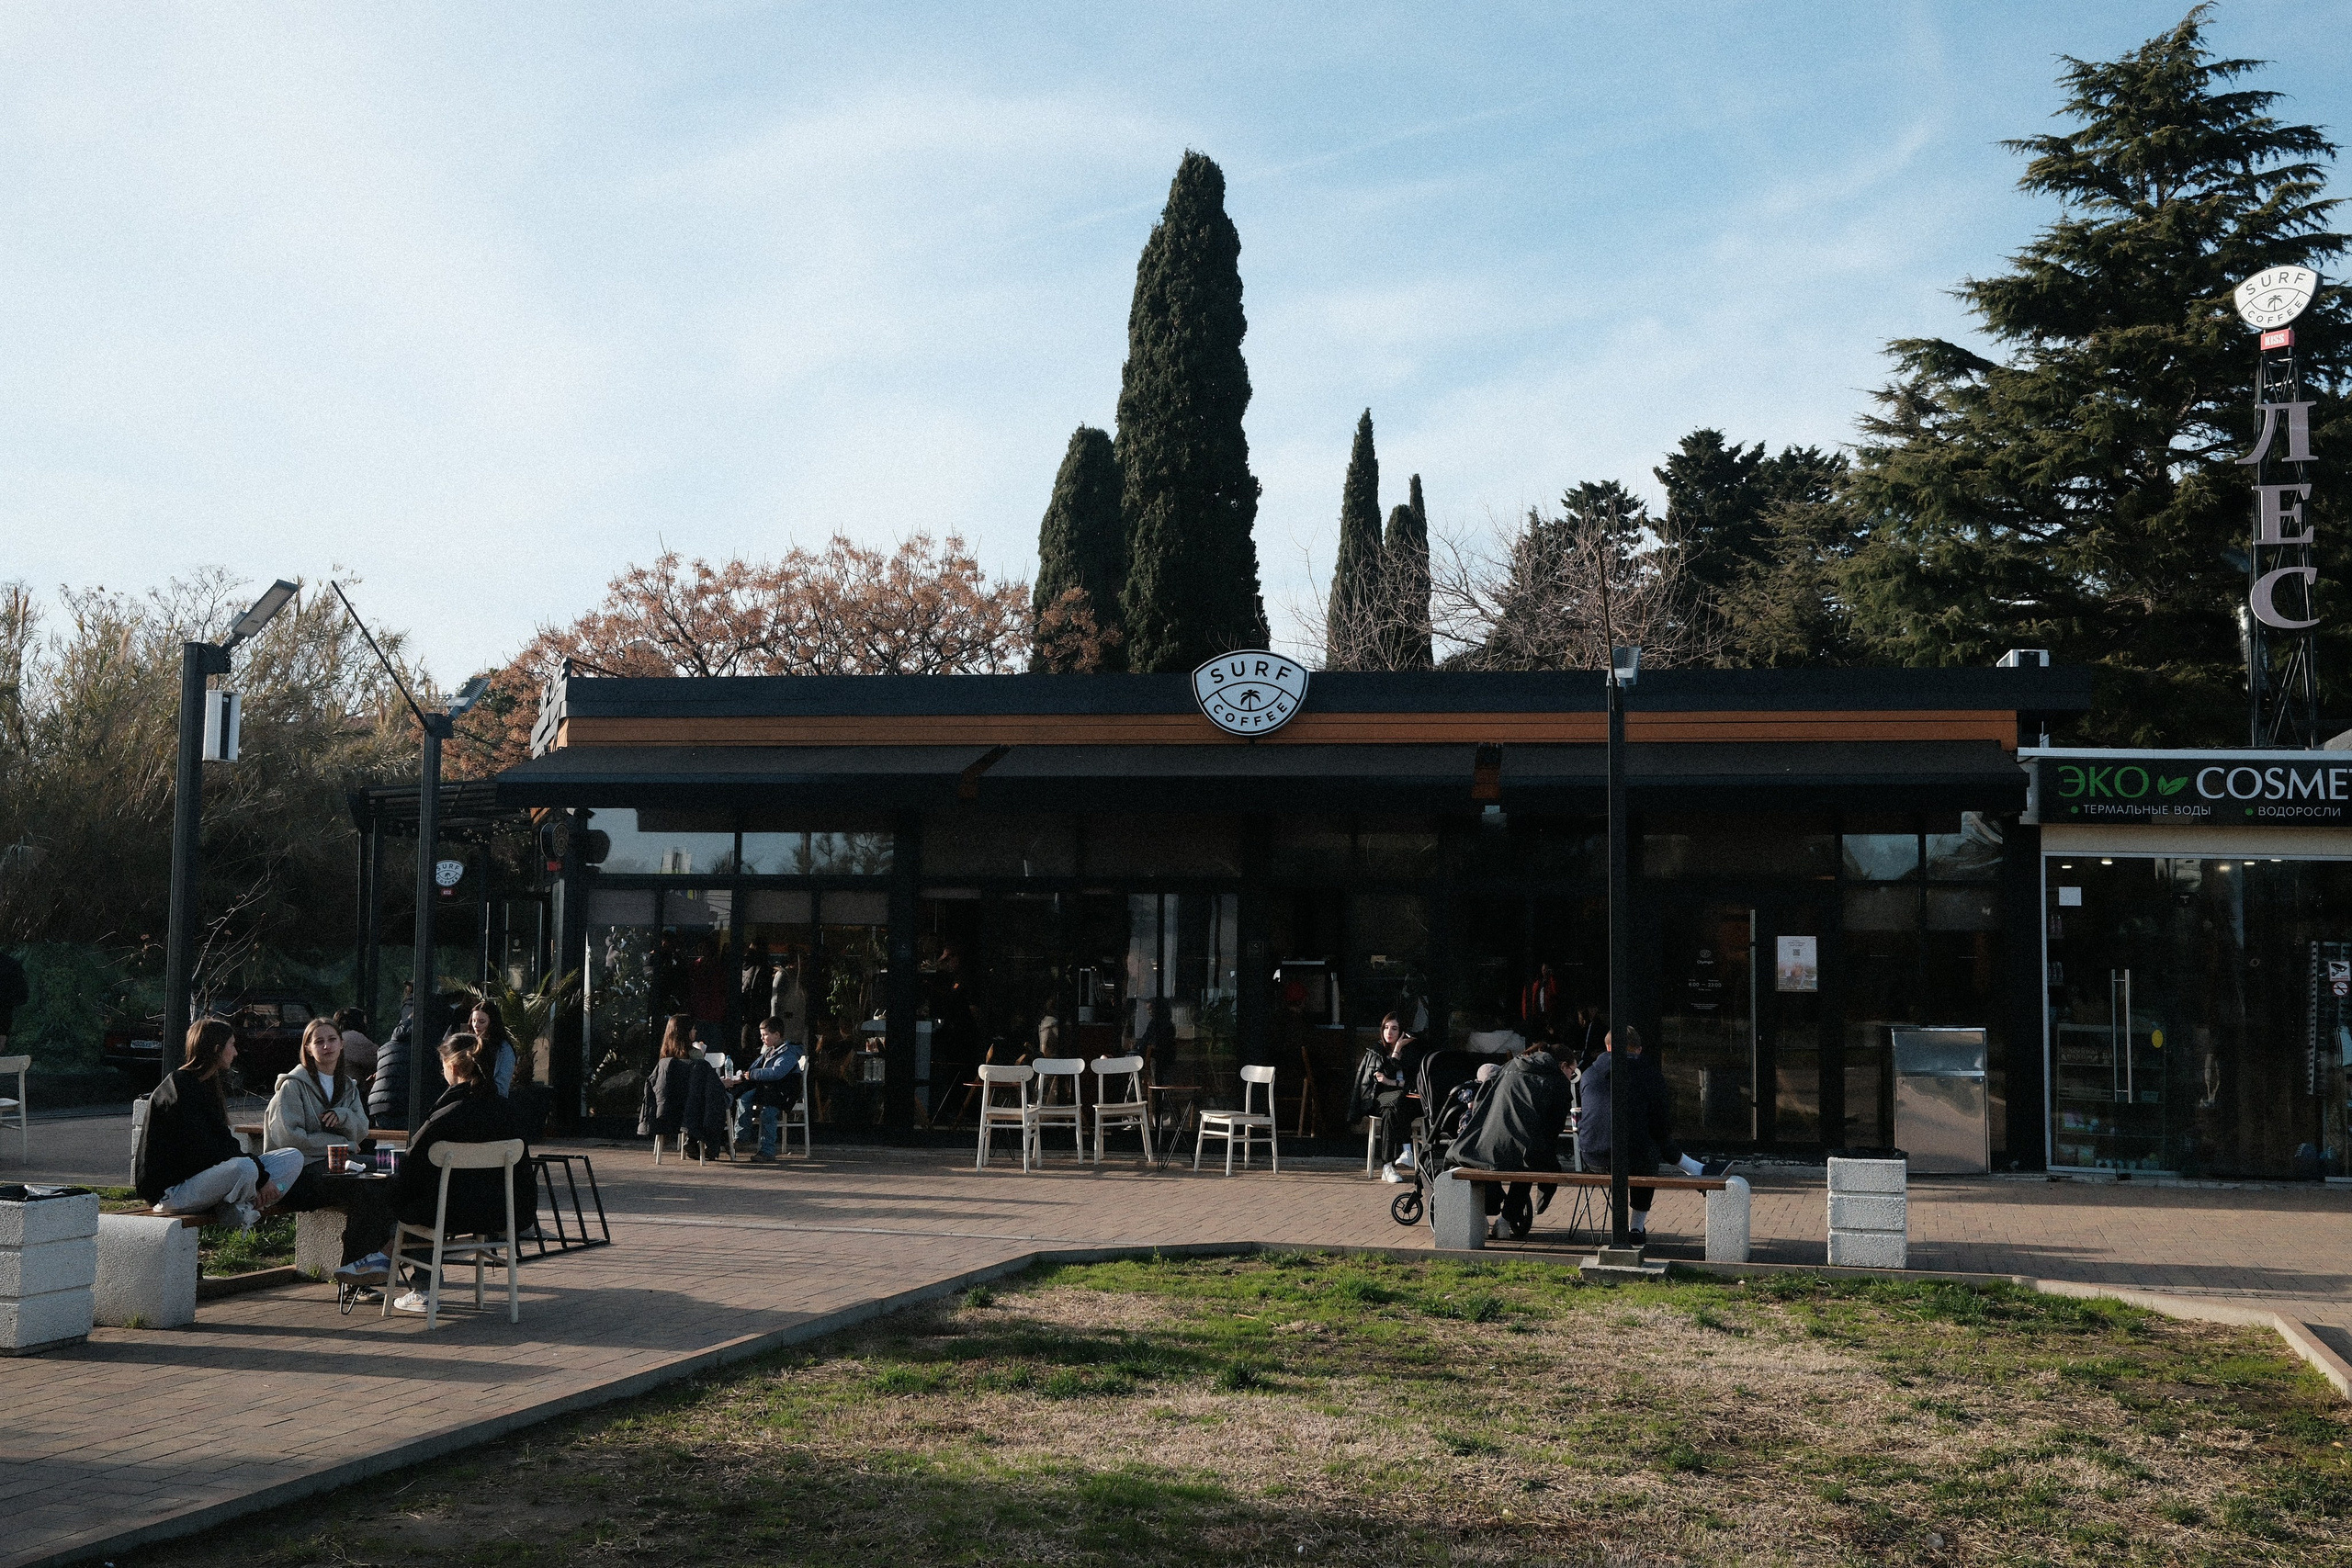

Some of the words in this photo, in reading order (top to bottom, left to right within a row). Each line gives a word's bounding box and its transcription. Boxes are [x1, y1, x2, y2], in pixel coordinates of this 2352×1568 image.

[2245, 271, 2306, 296] SURF
[2247, 300, 2303, 324] COFFEE
[2265, 333, 2285, 346] KISS
[2234, 400, 2320, 629] ЛЕС
[1210, 660, 1292, 683] SURF
[1214, 702, 1288, 727] COFFEE
[2058, 765, 2150, 798] ЭКО
[2196, 766, 2352, 800] COSME
[2083, 804, 2169, 816] ТЕРМАЛЬНЫЕ
[2174, 805, 2211, 817] ВОДЫ
[2257, 806, 2341, 818] ВОДОРОСЛИ
